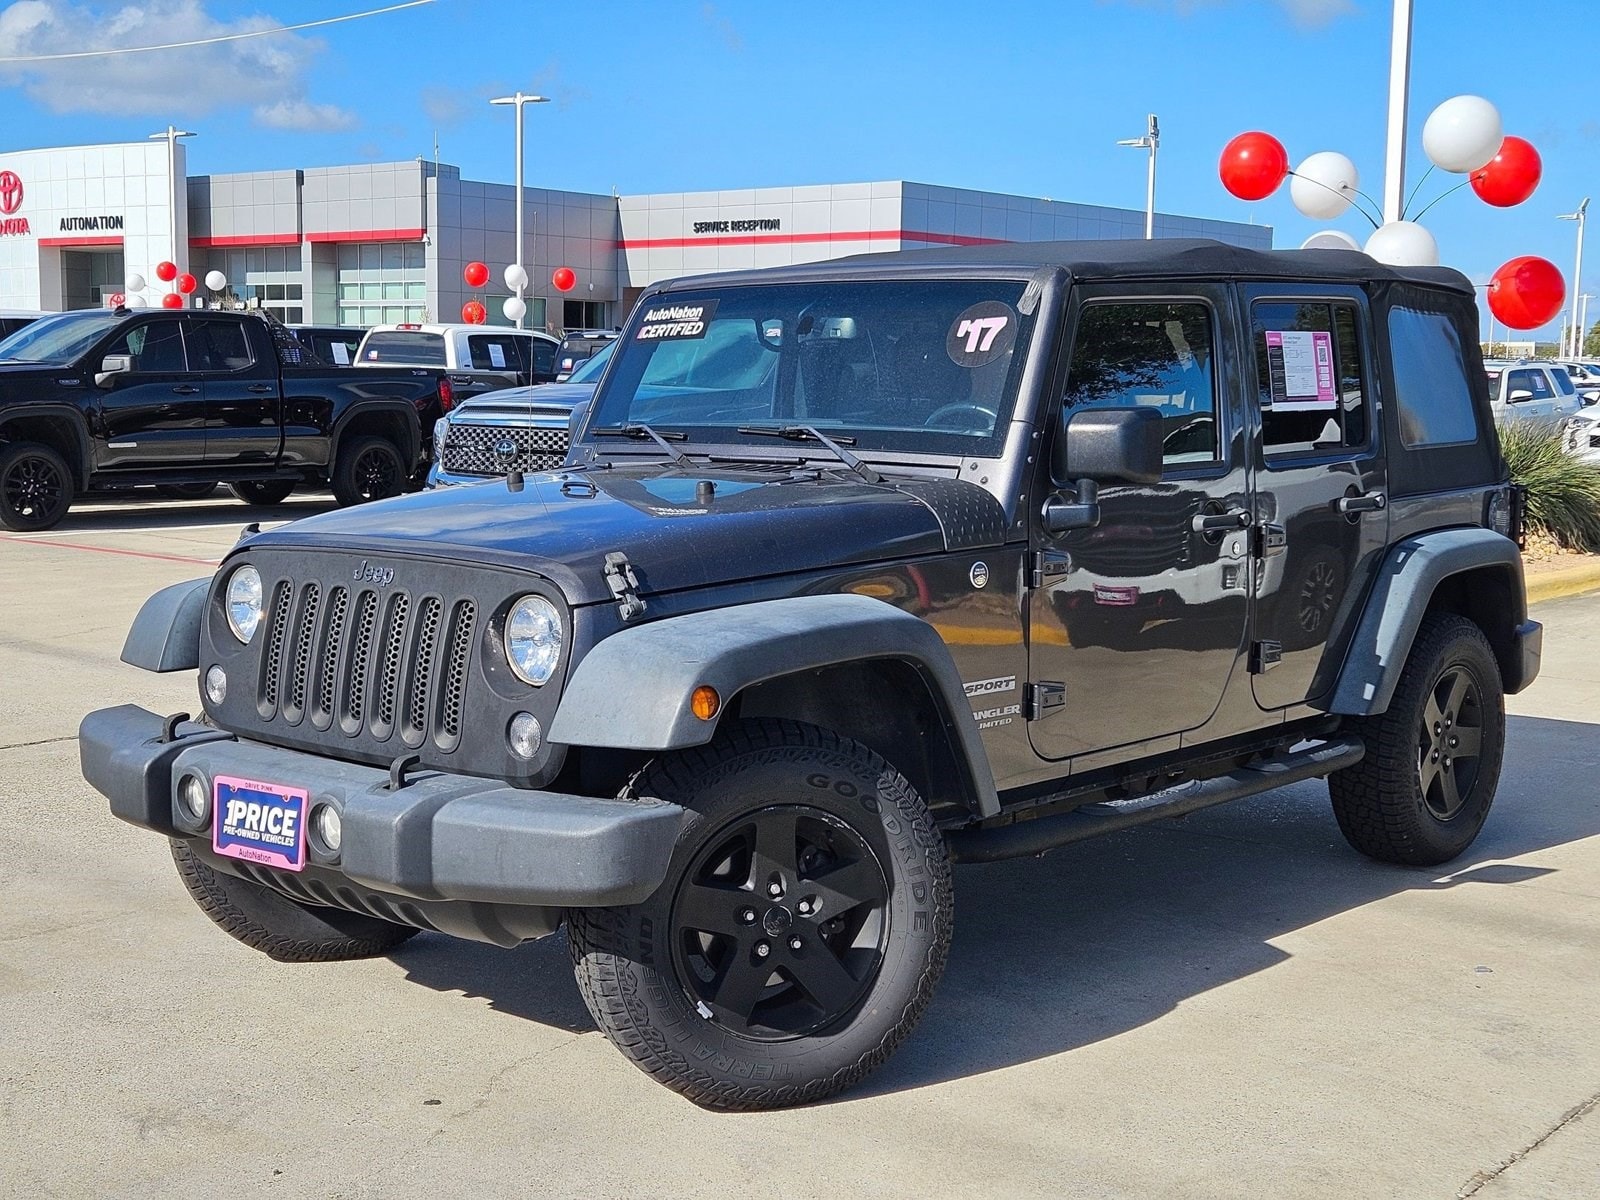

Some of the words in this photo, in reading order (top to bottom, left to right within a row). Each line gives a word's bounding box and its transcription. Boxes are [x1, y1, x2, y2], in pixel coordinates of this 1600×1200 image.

[0, 217, 30, 235] YOTA
[60, 216, 124, 231] AUTONATION
[693, 220, 730, 234] SERVICE
[730, 218, 780, 232] RECEPTION
[643, 305, 704, 322] AutoNation
[642, 321, 704, 339] CERTIFIED
[957, 316, 1008, 353] '17
[353, 560, 394, 587] Jeep
[964, 679, 1013, 693] SPORT
[978, 718, 1012, 730] IMITED
[245, 782, 260, 791] DRIVE
[223, 825, 260, 841] PRE-OWNED
[261, 833, 295, 847] VEHICLES
[239, 848, 272, 863] AutoNation
[806, 773, 930, 933] GOODRIDE
[639, 916, 693, 1043] LEGEND
[692, 1041, 795, 1081] TERRA
